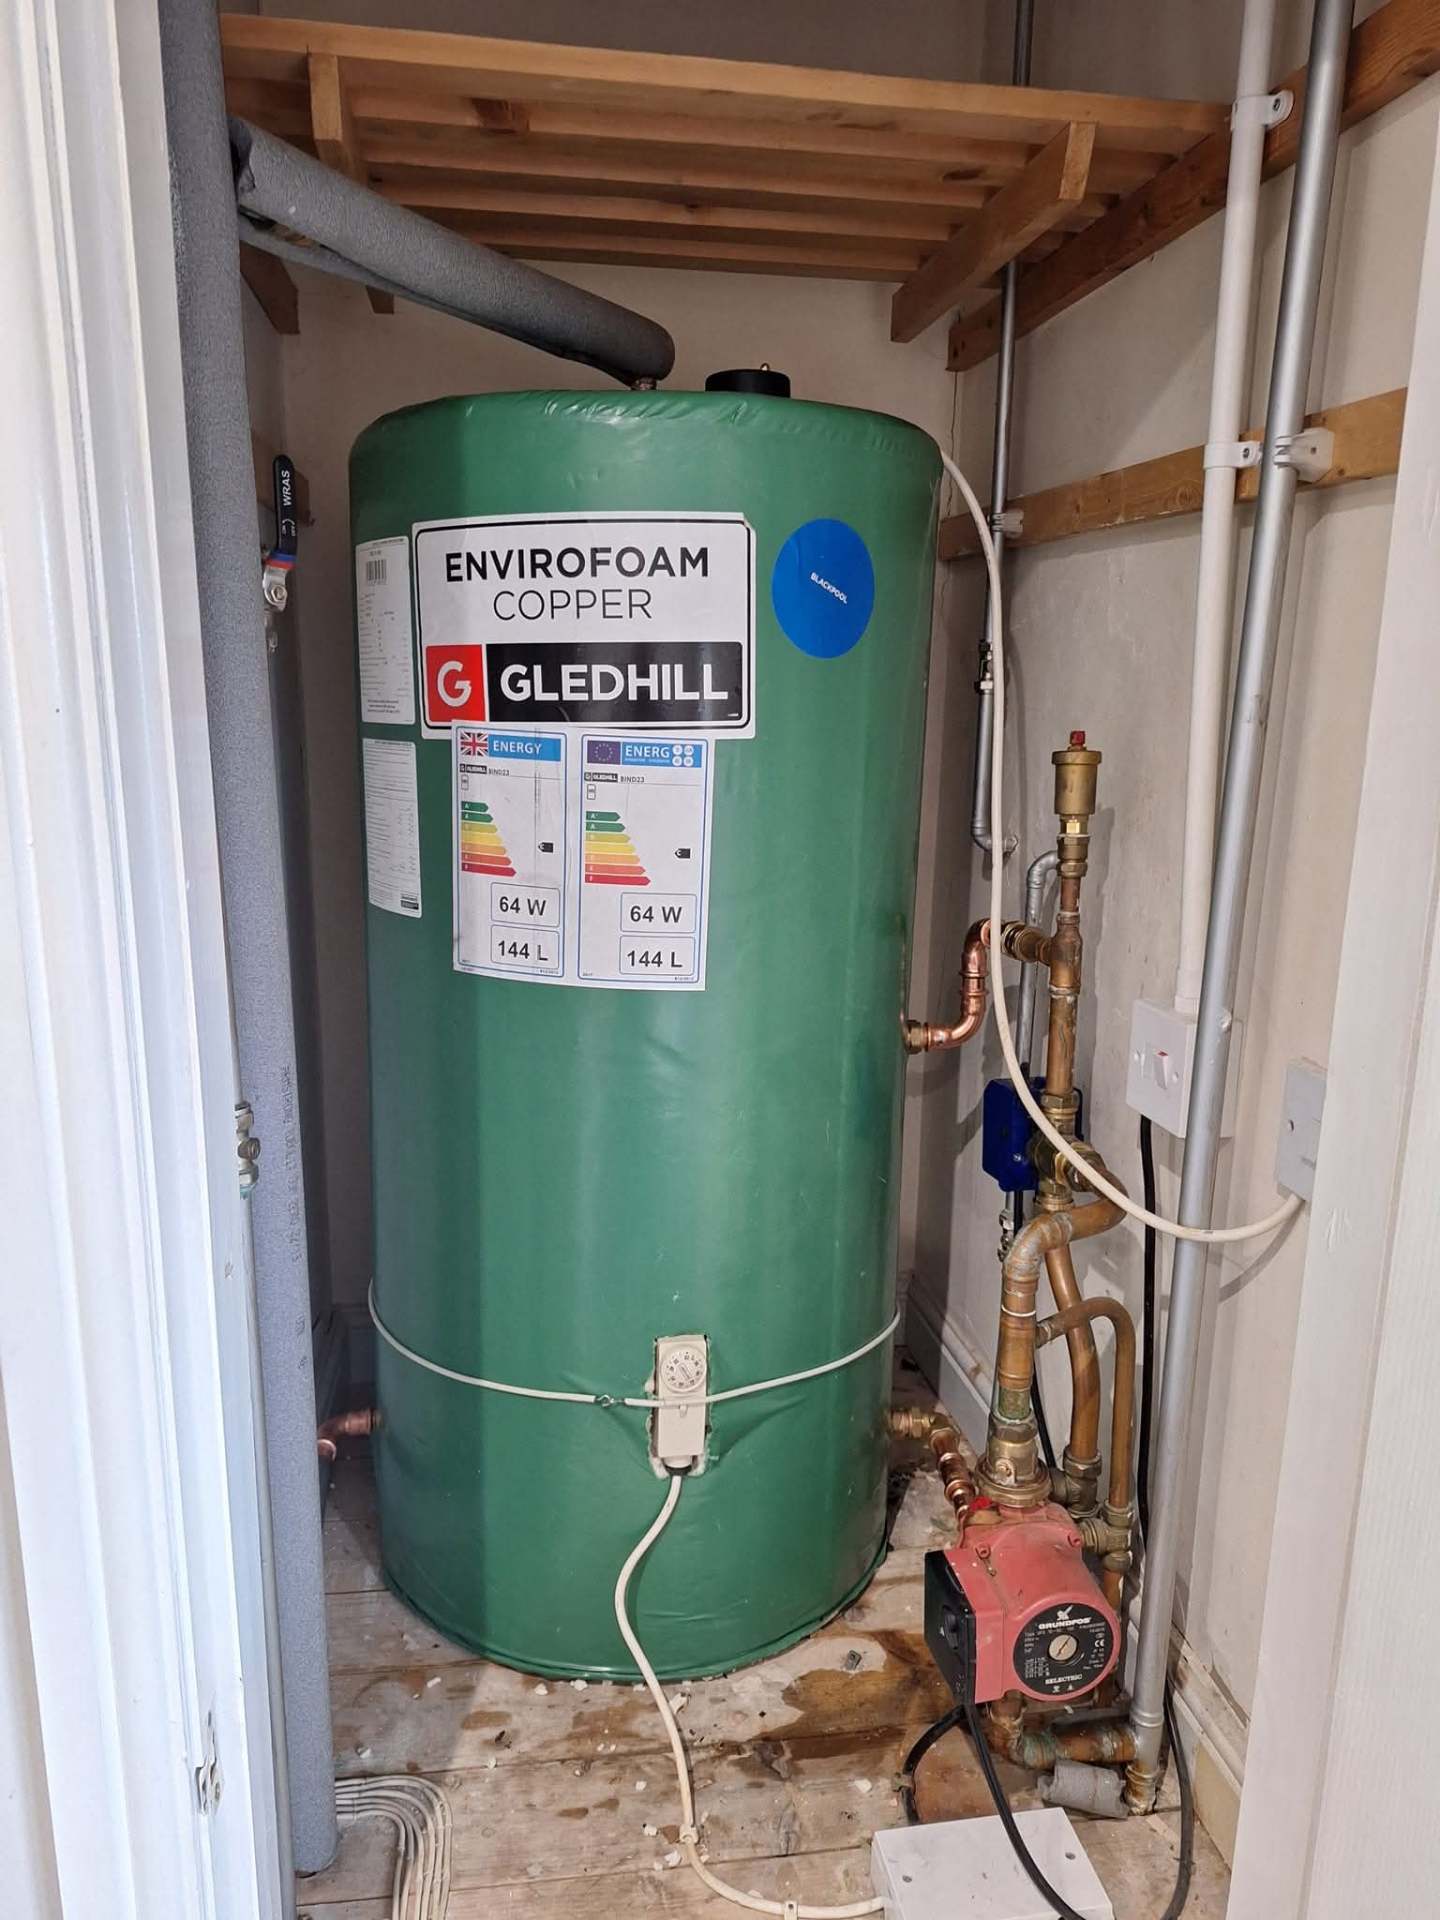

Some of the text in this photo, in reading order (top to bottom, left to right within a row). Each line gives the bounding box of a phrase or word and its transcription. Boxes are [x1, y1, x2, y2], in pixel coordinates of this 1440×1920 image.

[281, 470, 291, 506] WRAS
[446, 546, 709, 582] ENVIROFOAM
[810, 572, 848, 605] BLACKPOOL
[493, 588, 652, 621] COPPER
[437, 660, 729, 707] G GLEDHILL
[493, 739, 542, 755] ENERGY
[625, 745, 670, 758] ENERG
[499, 897, 548, 916] 64 W
[630, 906, 683, 923] 64 W
[498, 941, 549, 961] 144 L
[628, 951, 684, 968] 144 L
[1038, 1617, 1092, 1629] GRUNDFOS
